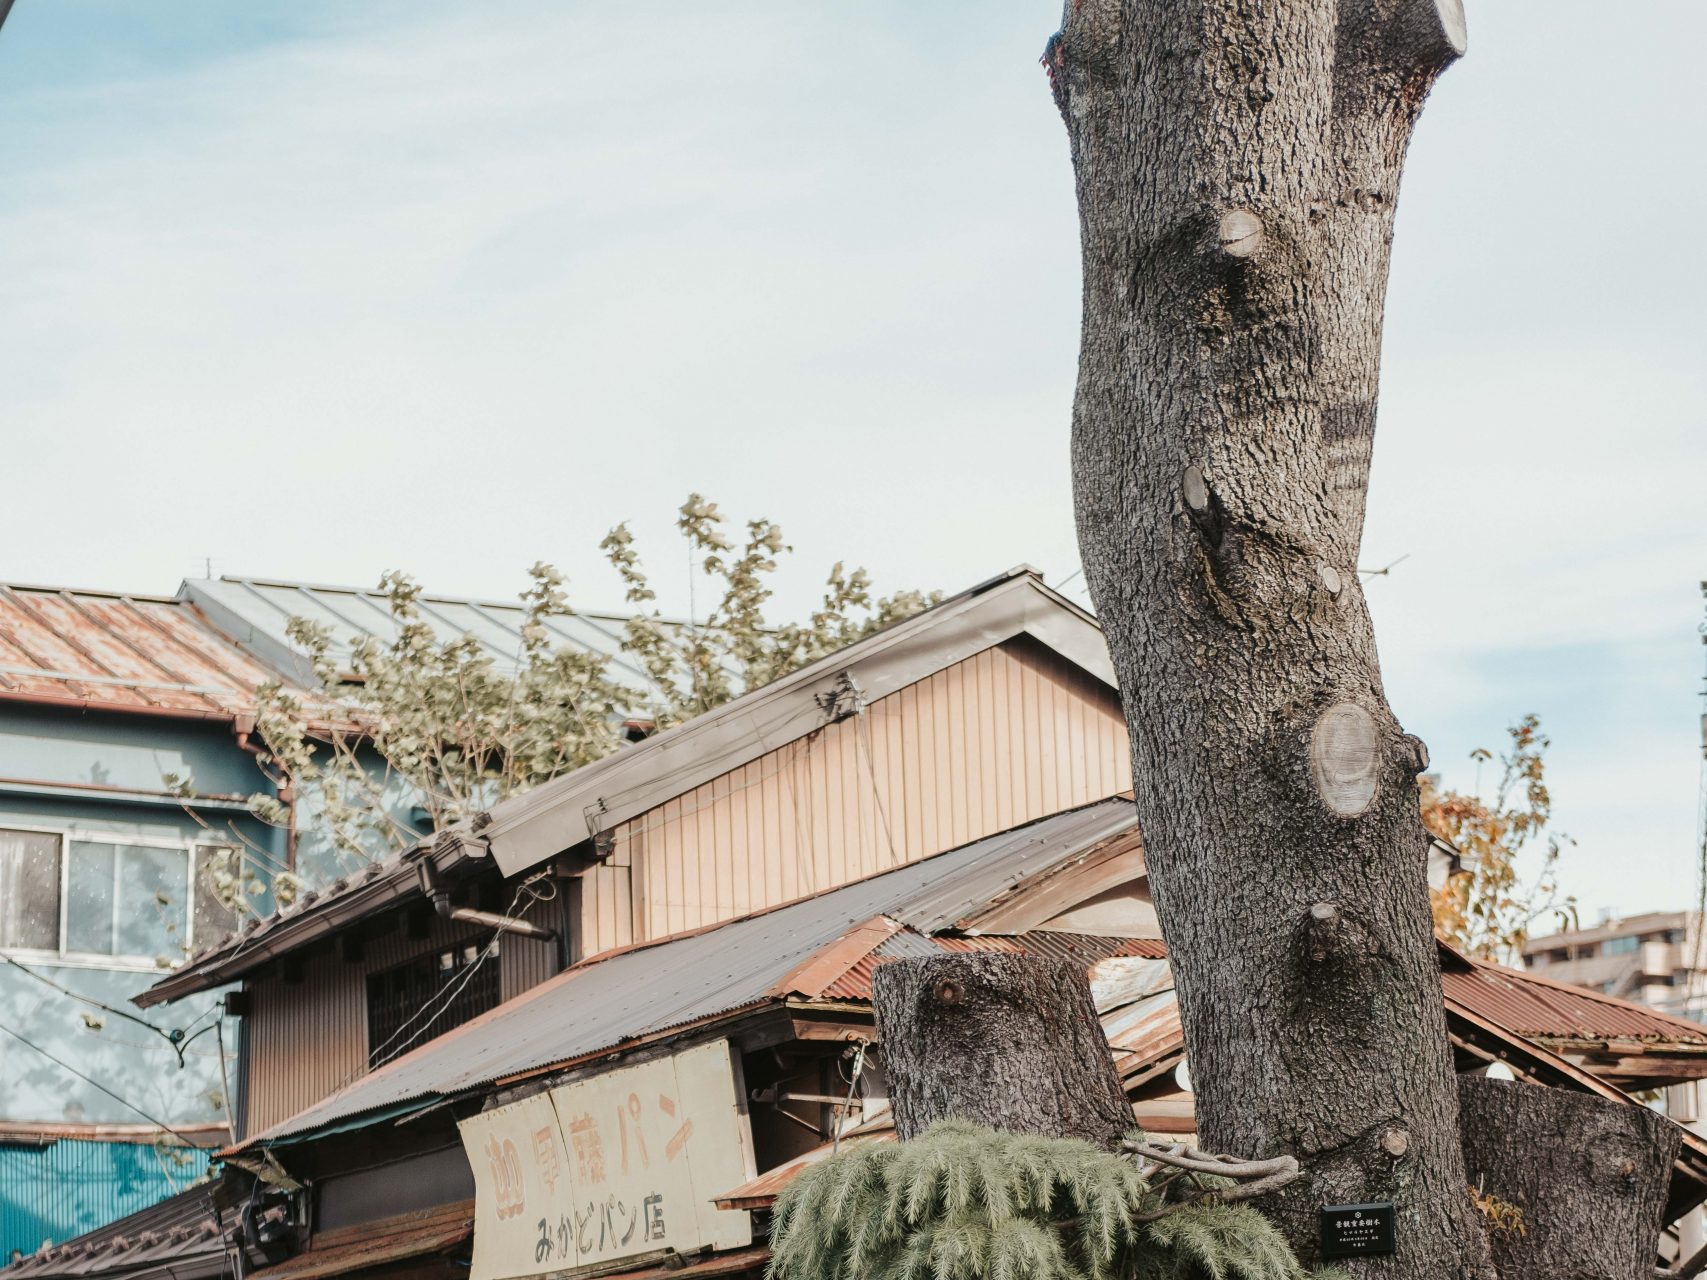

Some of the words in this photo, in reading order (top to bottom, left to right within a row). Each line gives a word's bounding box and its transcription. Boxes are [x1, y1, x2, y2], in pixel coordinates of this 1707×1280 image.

[535, 1191, 666, 1264] みかどパン店
